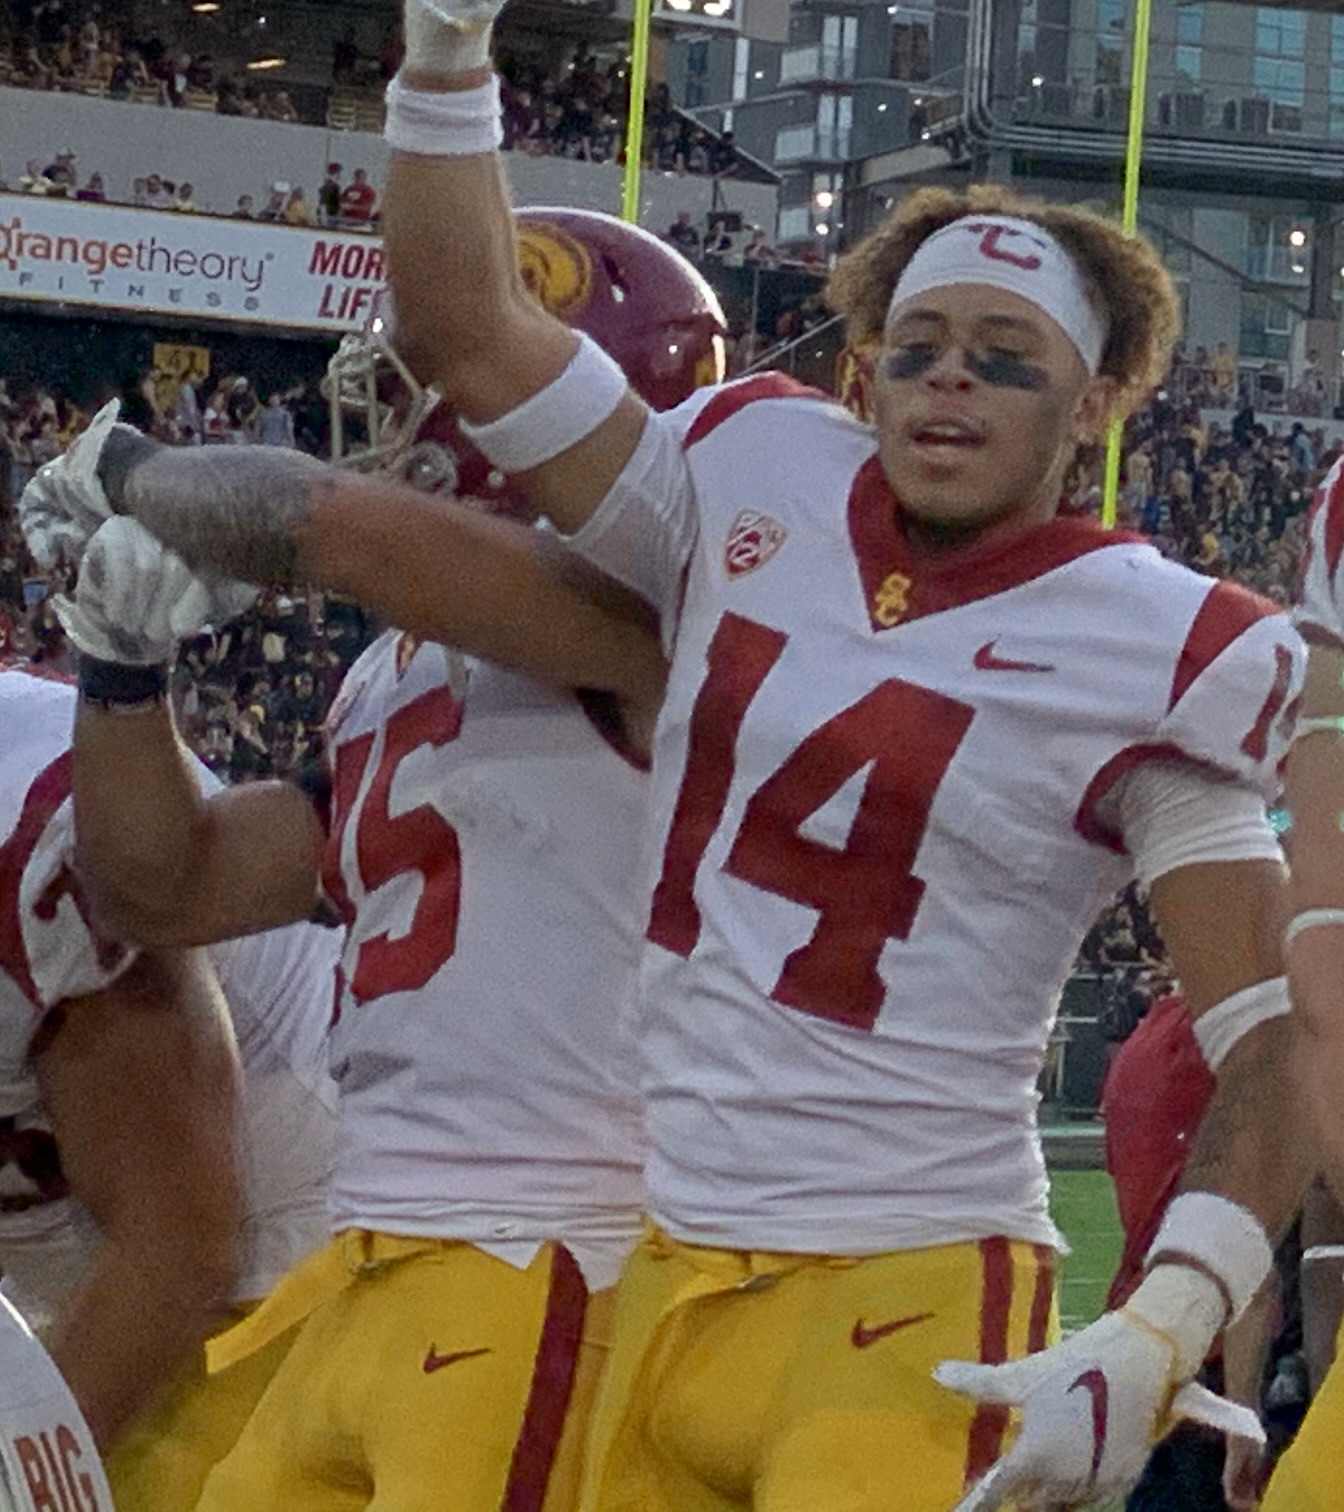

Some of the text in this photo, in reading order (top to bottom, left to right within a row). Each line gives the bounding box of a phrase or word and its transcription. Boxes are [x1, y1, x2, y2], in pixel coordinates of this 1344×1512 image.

[309, 241, 386, 281] MOR
[19, 271, 260, 311] FITNESS
[317, 284, 378, 321] LIF
[645, 609, 976, 1033] 14
